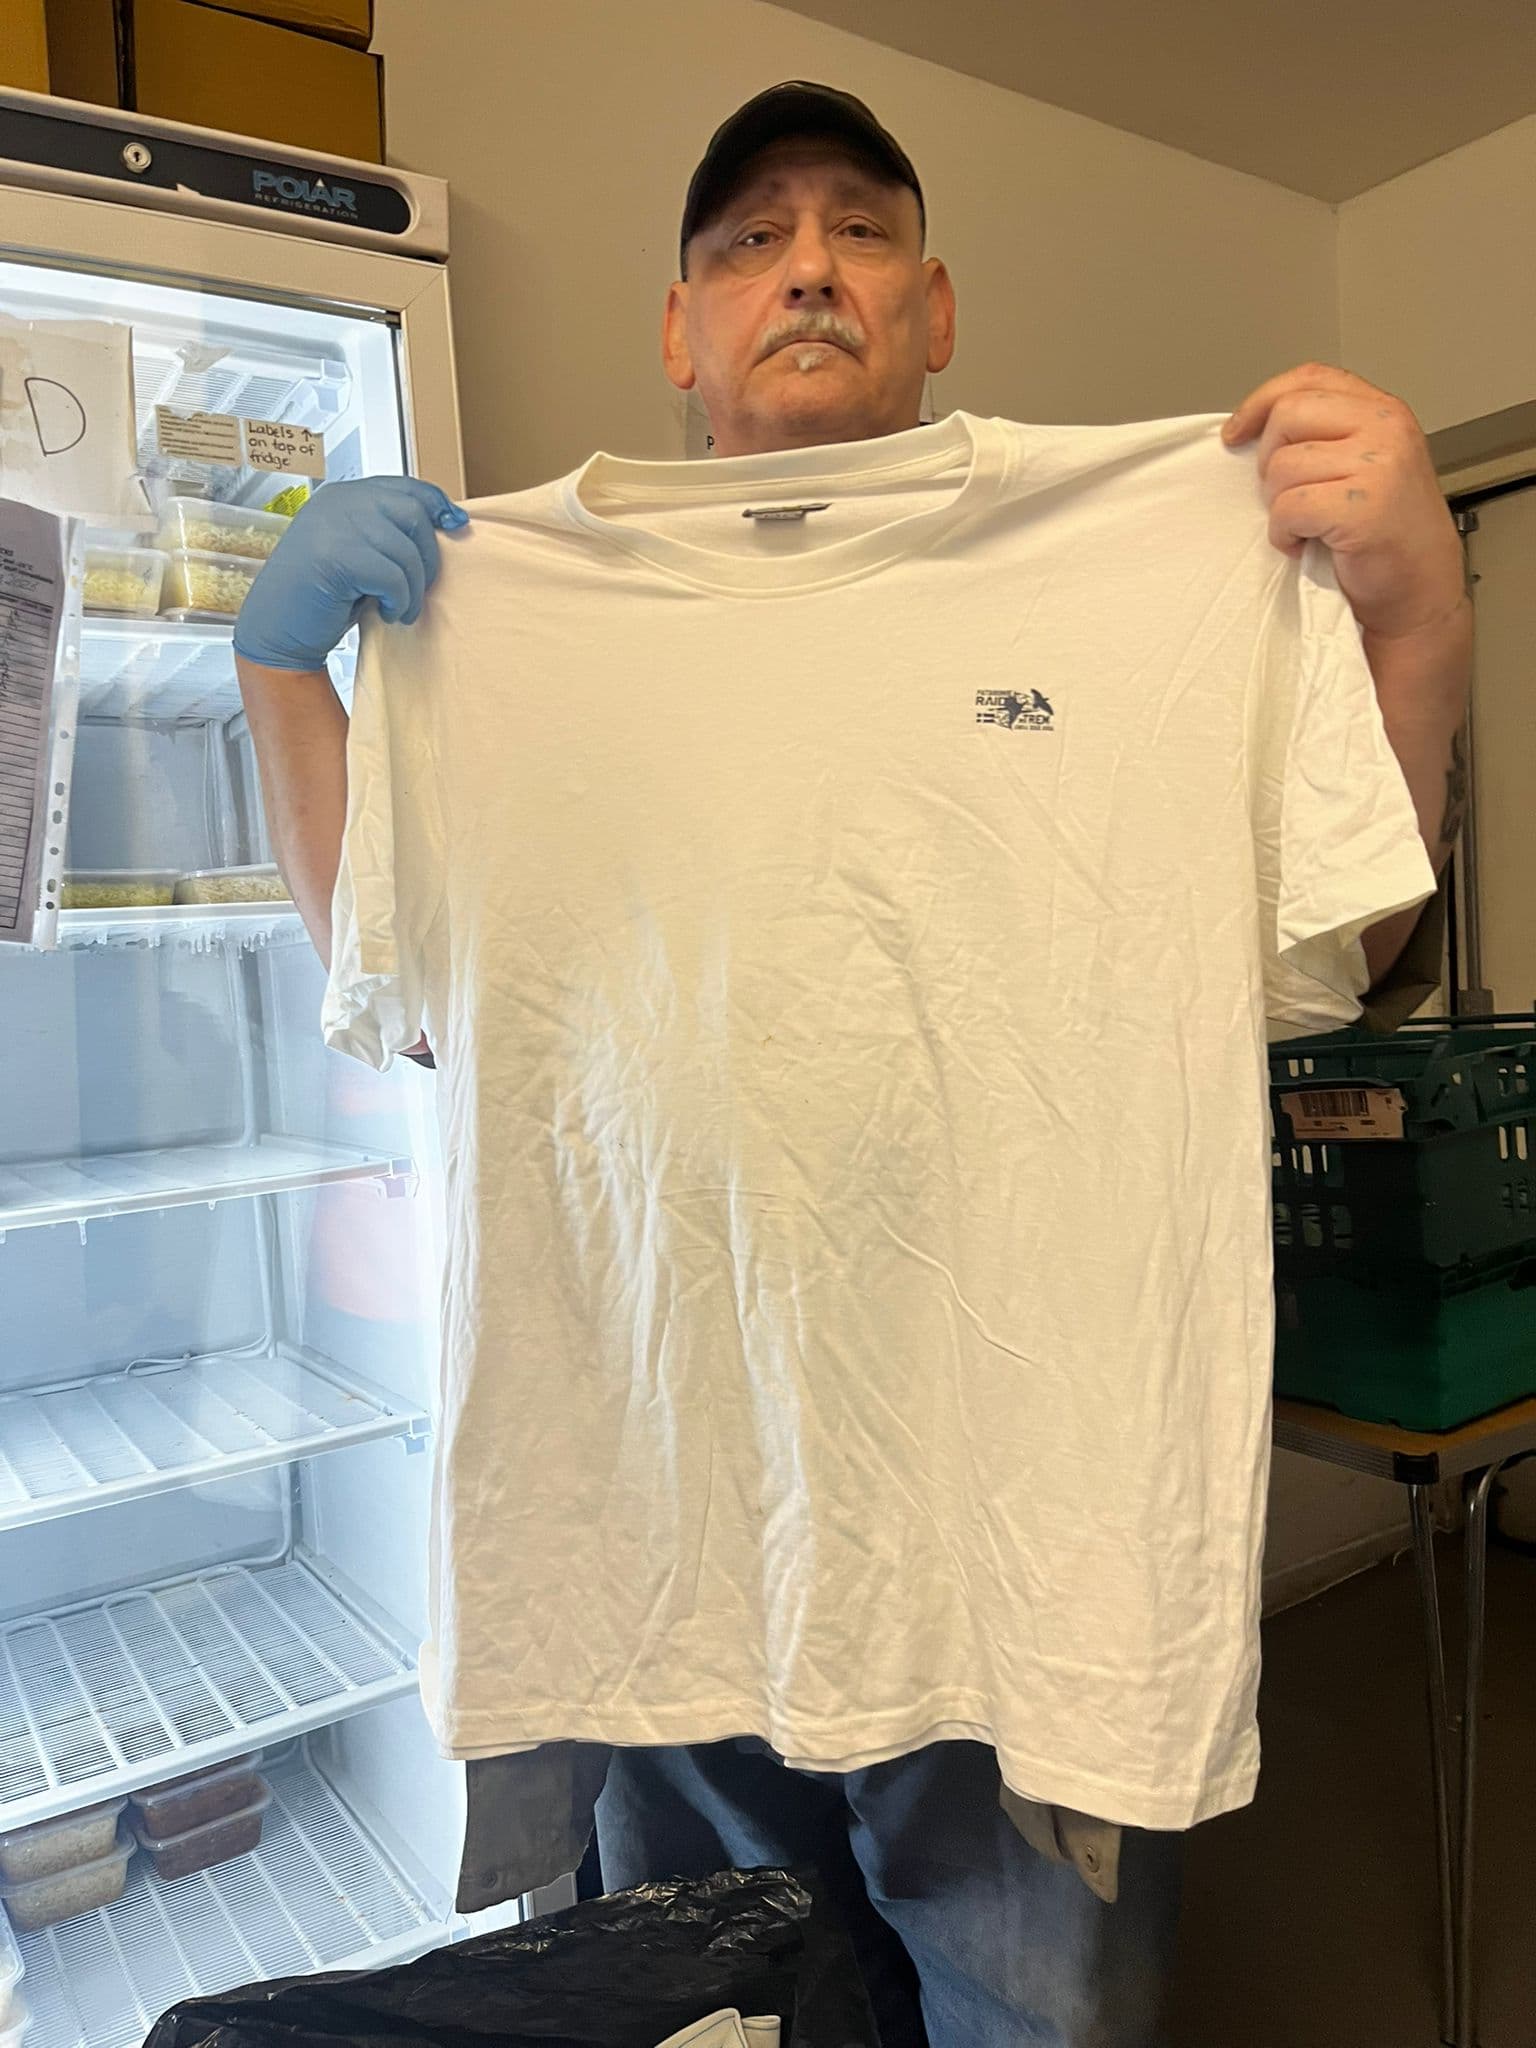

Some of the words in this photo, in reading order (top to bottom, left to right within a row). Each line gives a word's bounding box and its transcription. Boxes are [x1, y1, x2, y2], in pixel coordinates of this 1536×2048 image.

[253, 170, 357, 212] POLAR
[254, 193, 359, 219] REFRIGERATION
[248, 422, 294, 439] Labels
[248, 437, 268, 448] on
[272, 438, 296, 455] top
[299, 443, 316, 456] of
[249, 450, 291, 469] fridge
